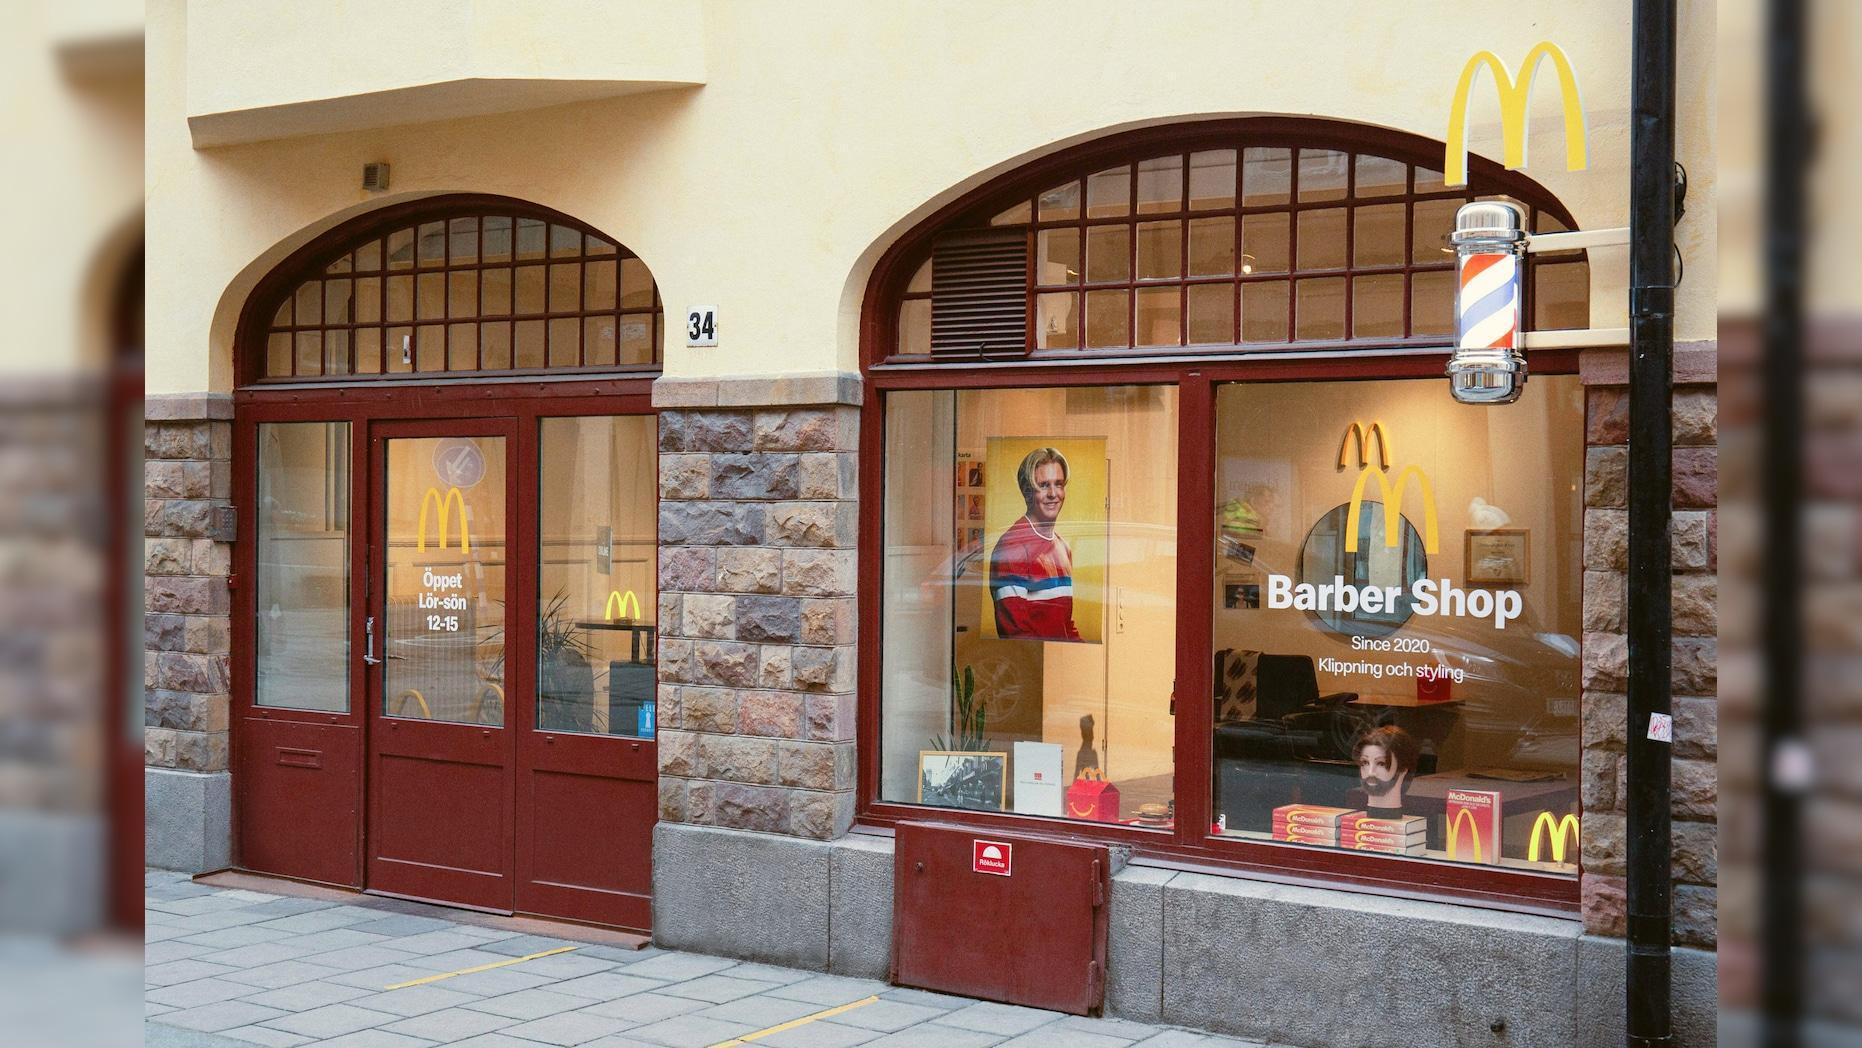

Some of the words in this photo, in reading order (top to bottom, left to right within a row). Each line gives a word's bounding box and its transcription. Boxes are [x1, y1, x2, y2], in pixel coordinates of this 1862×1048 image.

[689, 311, 714, 341] 34
[423, 566, 463, 592] Öppet
[418, 592, 467, 610] Lör-sön
[1267, 574, 1402, 614] Barber
[1411, 578, 1523, 629] Shop
[426, 615, 459, 632] 12-15
[1351, 636, 1391, 652] Since
[1393, 638, 1430, 653] 2020
[1318, 657, 1383, 678] Klippning
[1388, 663, 1413, 677] och
[1416, 664, 1464, 684] styling
[1448, 791, 1491, 804] McDonald's
